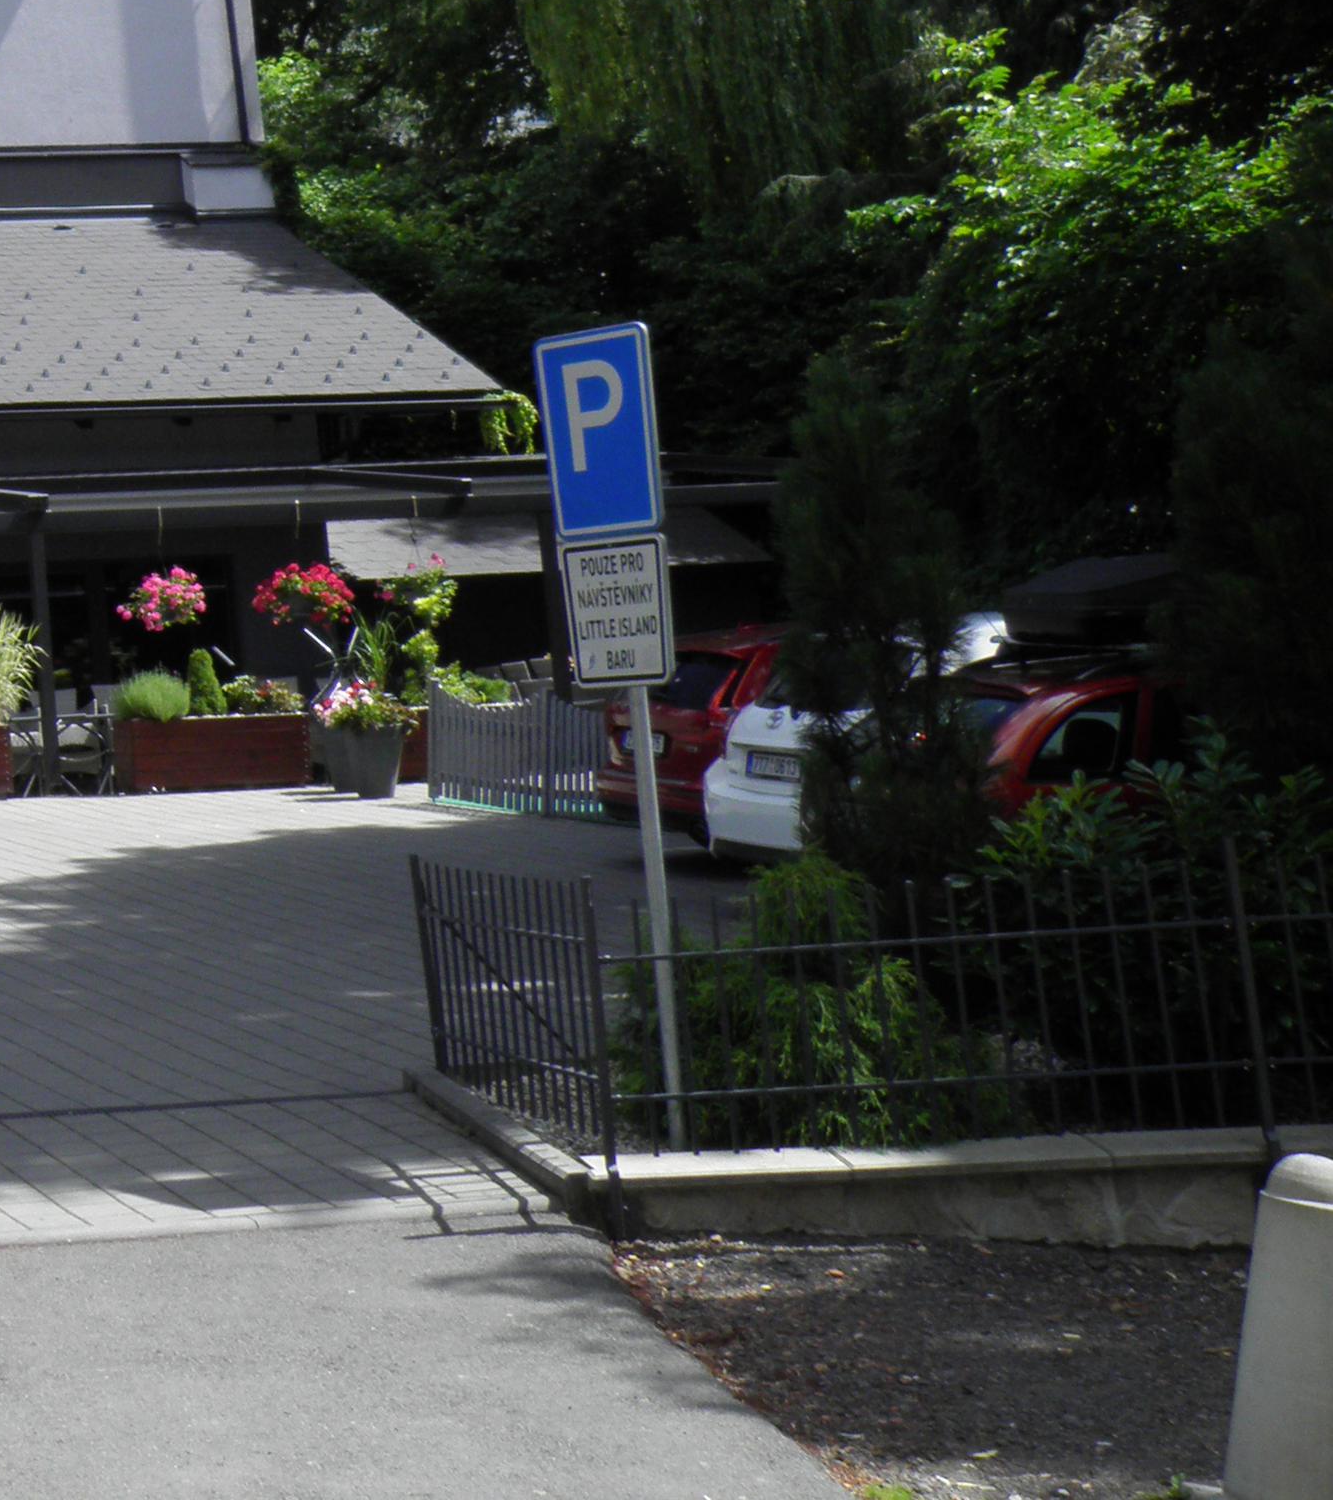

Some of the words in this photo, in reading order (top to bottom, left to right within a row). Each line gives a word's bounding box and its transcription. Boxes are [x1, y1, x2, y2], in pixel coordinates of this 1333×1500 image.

[562, 359, 623, 472] P
[580, 554, 618, 577] POUZE
[620, 552, 644, 573] PRO
[577, 579, 653, 608] NÁVŠTĚVNÍKY
[579, 618, 617, 640] LITTLE
[619, 615, 658, 638] ISLAND
[606, 649, 636, 670] BARU
